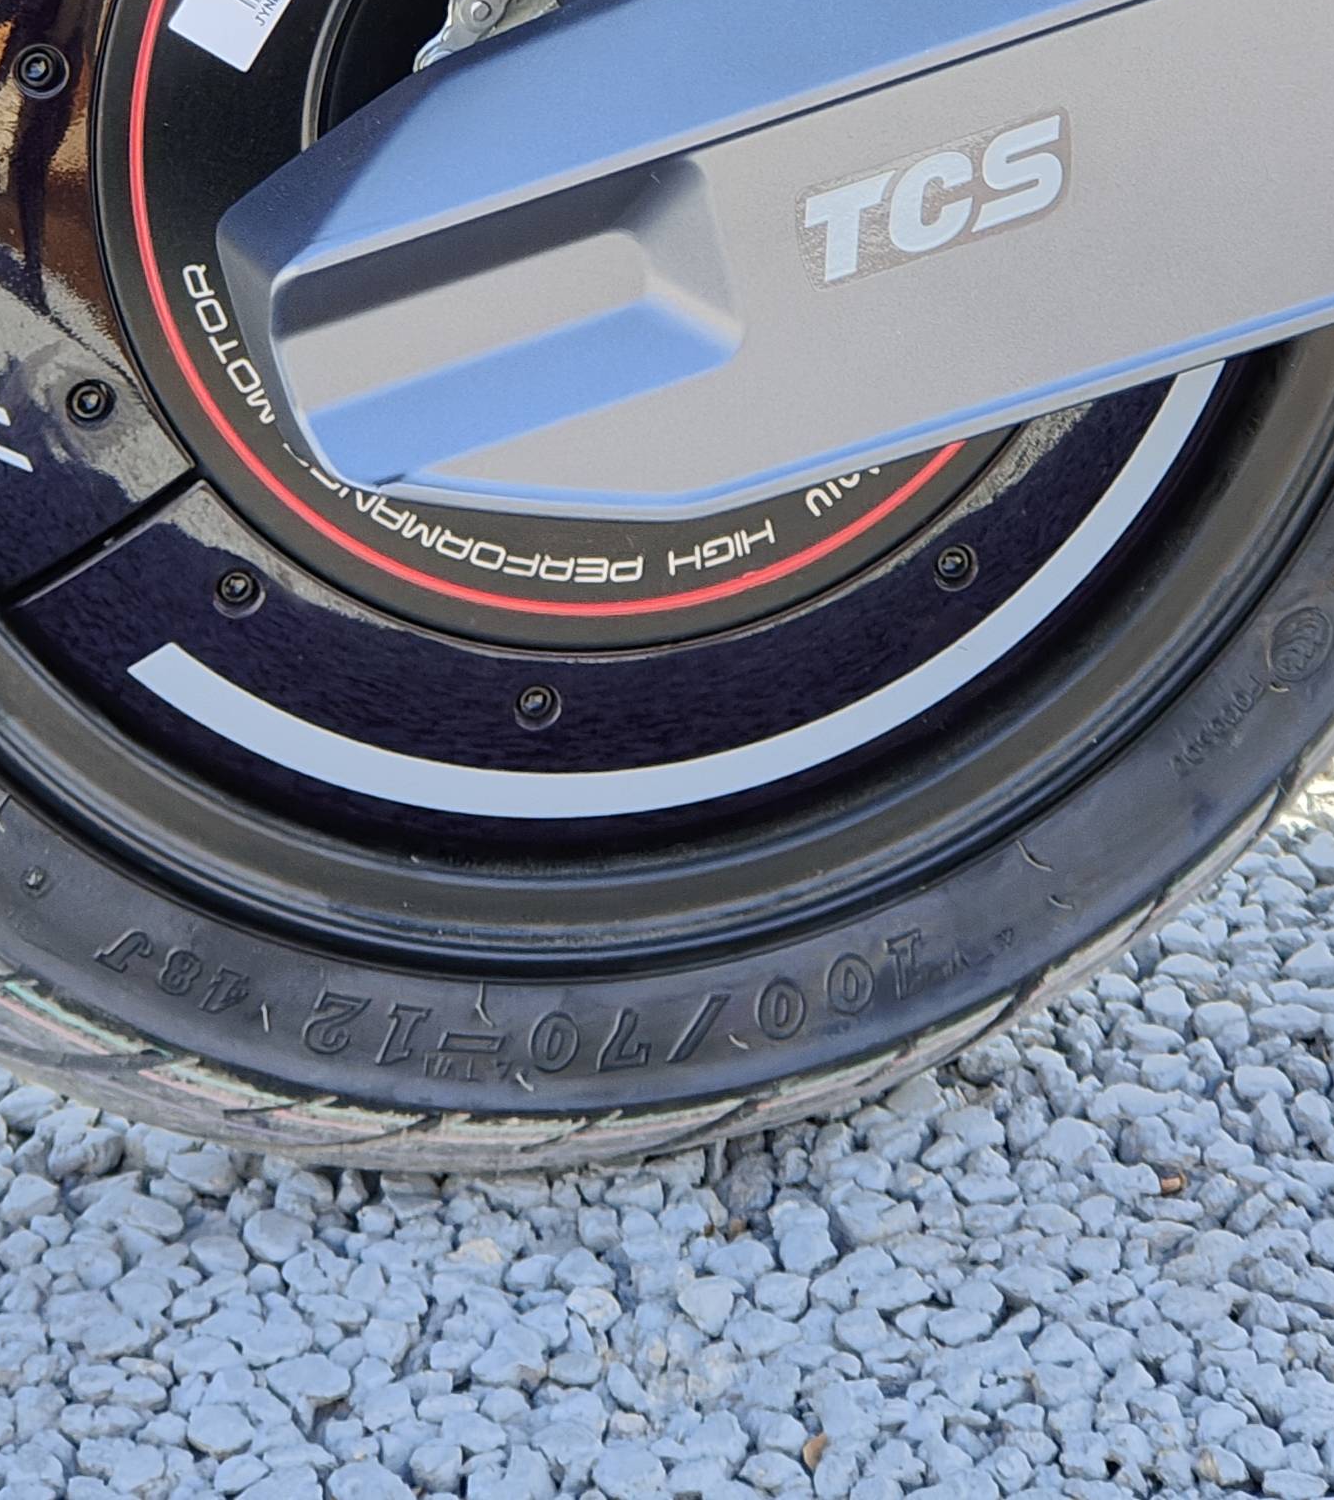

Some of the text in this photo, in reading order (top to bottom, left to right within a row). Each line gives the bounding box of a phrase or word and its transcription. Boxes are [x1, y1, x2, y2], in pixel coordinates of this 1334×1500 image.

[804, 114, 1064, 283] TCS
[182, 264, 276, 425] MOTOR
[283, 442, 644, 584] PERFORMAN
[668, 518, 776, 577] HIGH
[301, 926, 922, 1073] 100/70-12
